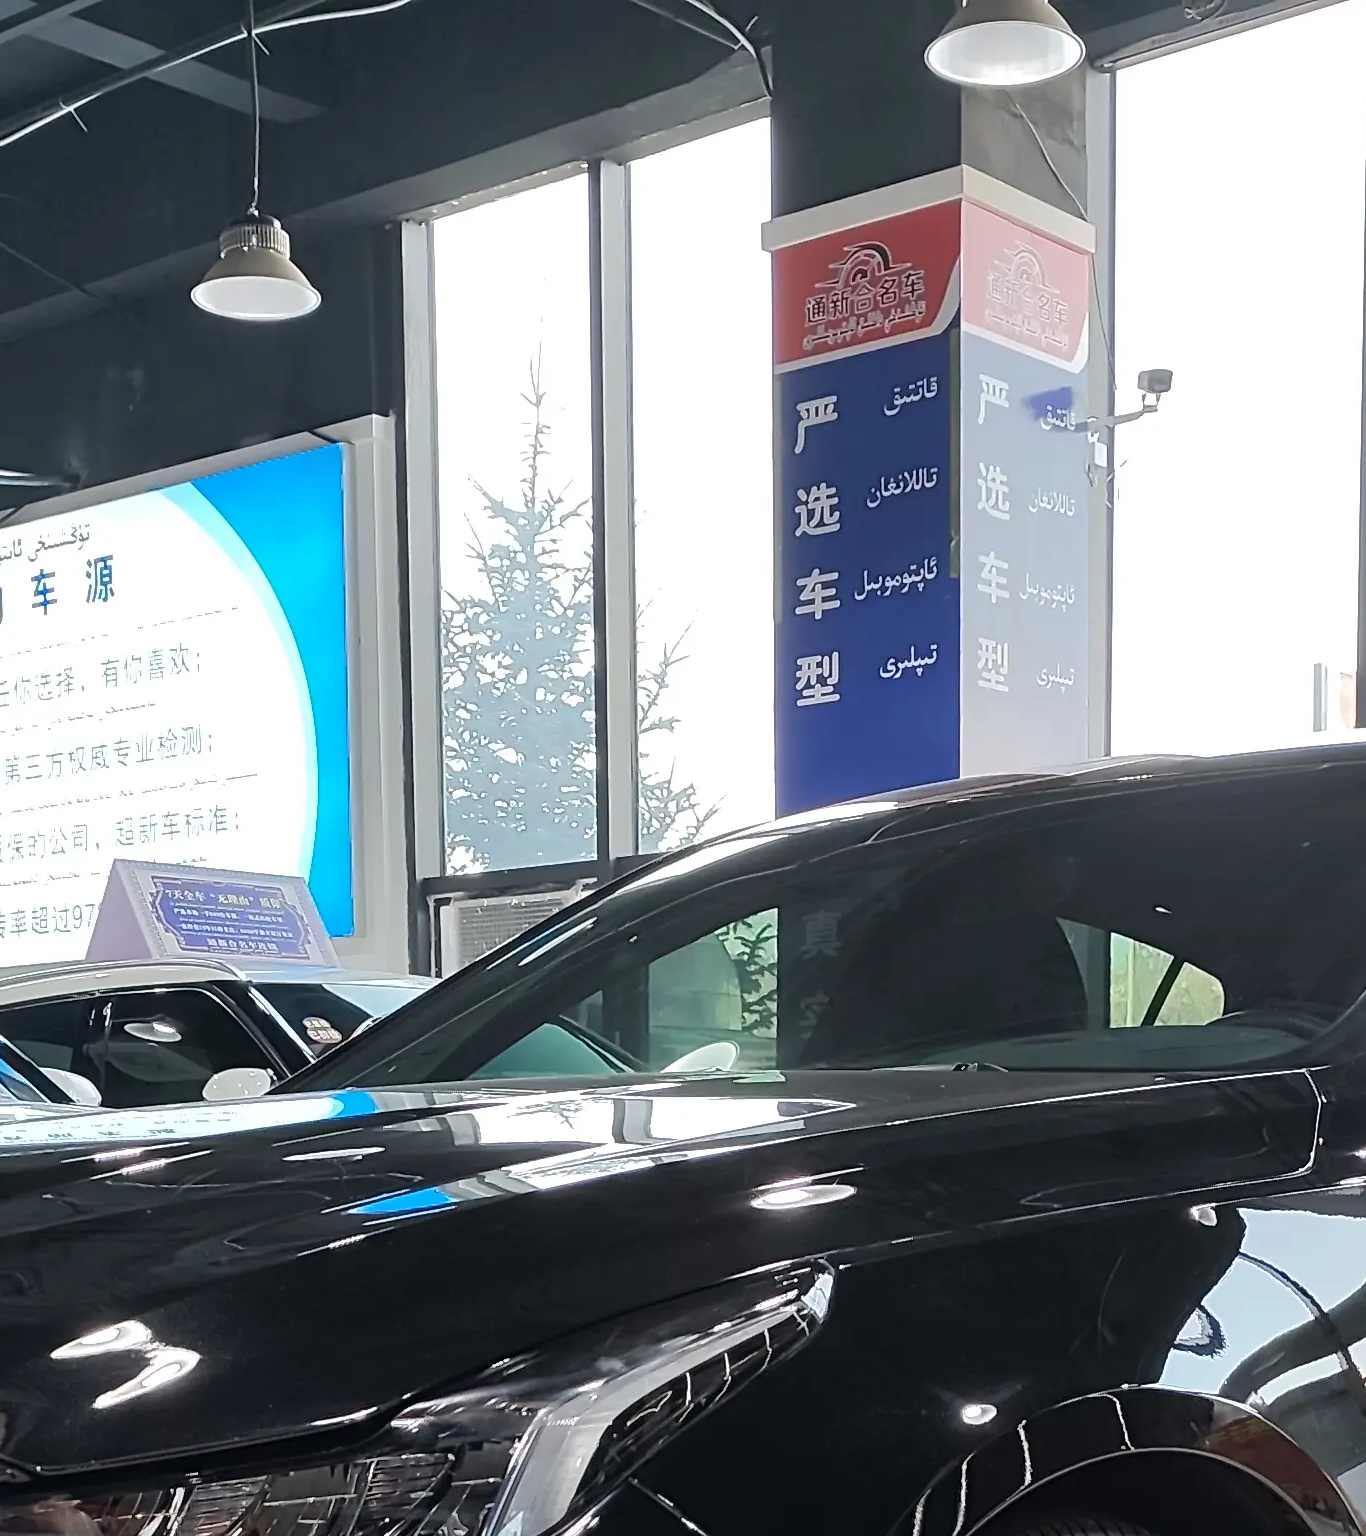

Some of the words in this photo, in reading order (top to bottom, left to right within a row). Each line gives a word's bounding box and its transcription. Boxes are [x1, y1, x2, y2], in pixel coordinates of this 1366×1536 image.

[793, 395, 841, 707] 严选车型
[977, 373, 1010, 692] 严选车型
